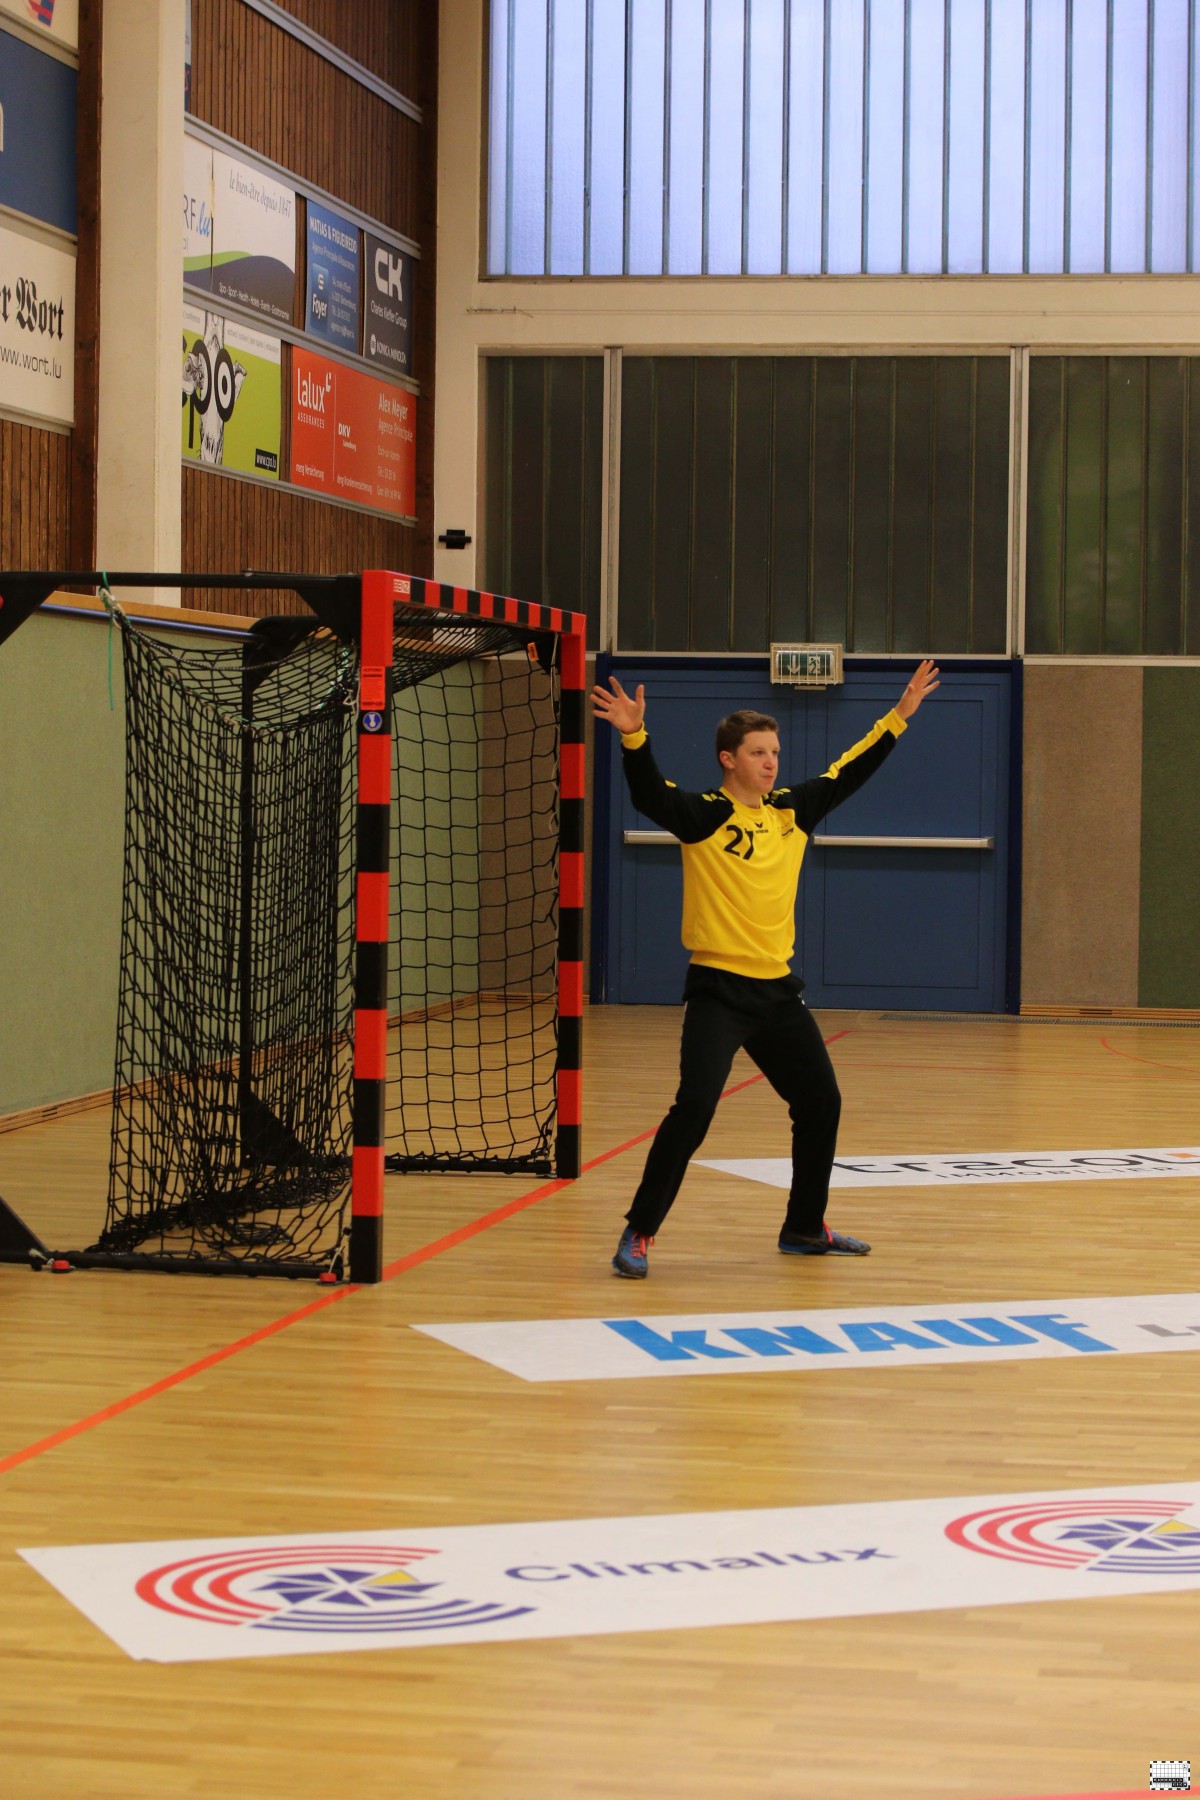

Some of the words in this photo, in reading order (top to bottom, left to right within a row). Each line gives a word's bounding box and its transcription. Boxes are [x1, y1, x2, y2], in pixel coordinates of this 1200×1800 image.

[310, 216, 327, 238] MATIAS
[327, 225, 332, 241] &
[332, 227, 358, 254] FIGUEIREDO
[374, 247, 403, 302] CK
[0, 284, 11, 323] r
[16, 277, 64, 341] Wort
[312, 293, 328, 320] Foyer
[371, 299, 384, 318] Charles
[395, 312, 408, 331] Group
[376, 340, 391, 357] KONICA
[391, 347, 407, 364] MINOLTA
[297, 367, 325, 413] lalux
[297, 411, 325, 429] ASSURANCES
[378, 392, 391, 415] Alex
[391, 397, 408, 422] Meyer
[338, 422, 351, 438] DKV
[379, 418, 393, 436] Agence
[393, 422, 413, 442] Principale
[394, 579, 410, 593] BENZ
[504, 1547, 898, 1582] Climalux
